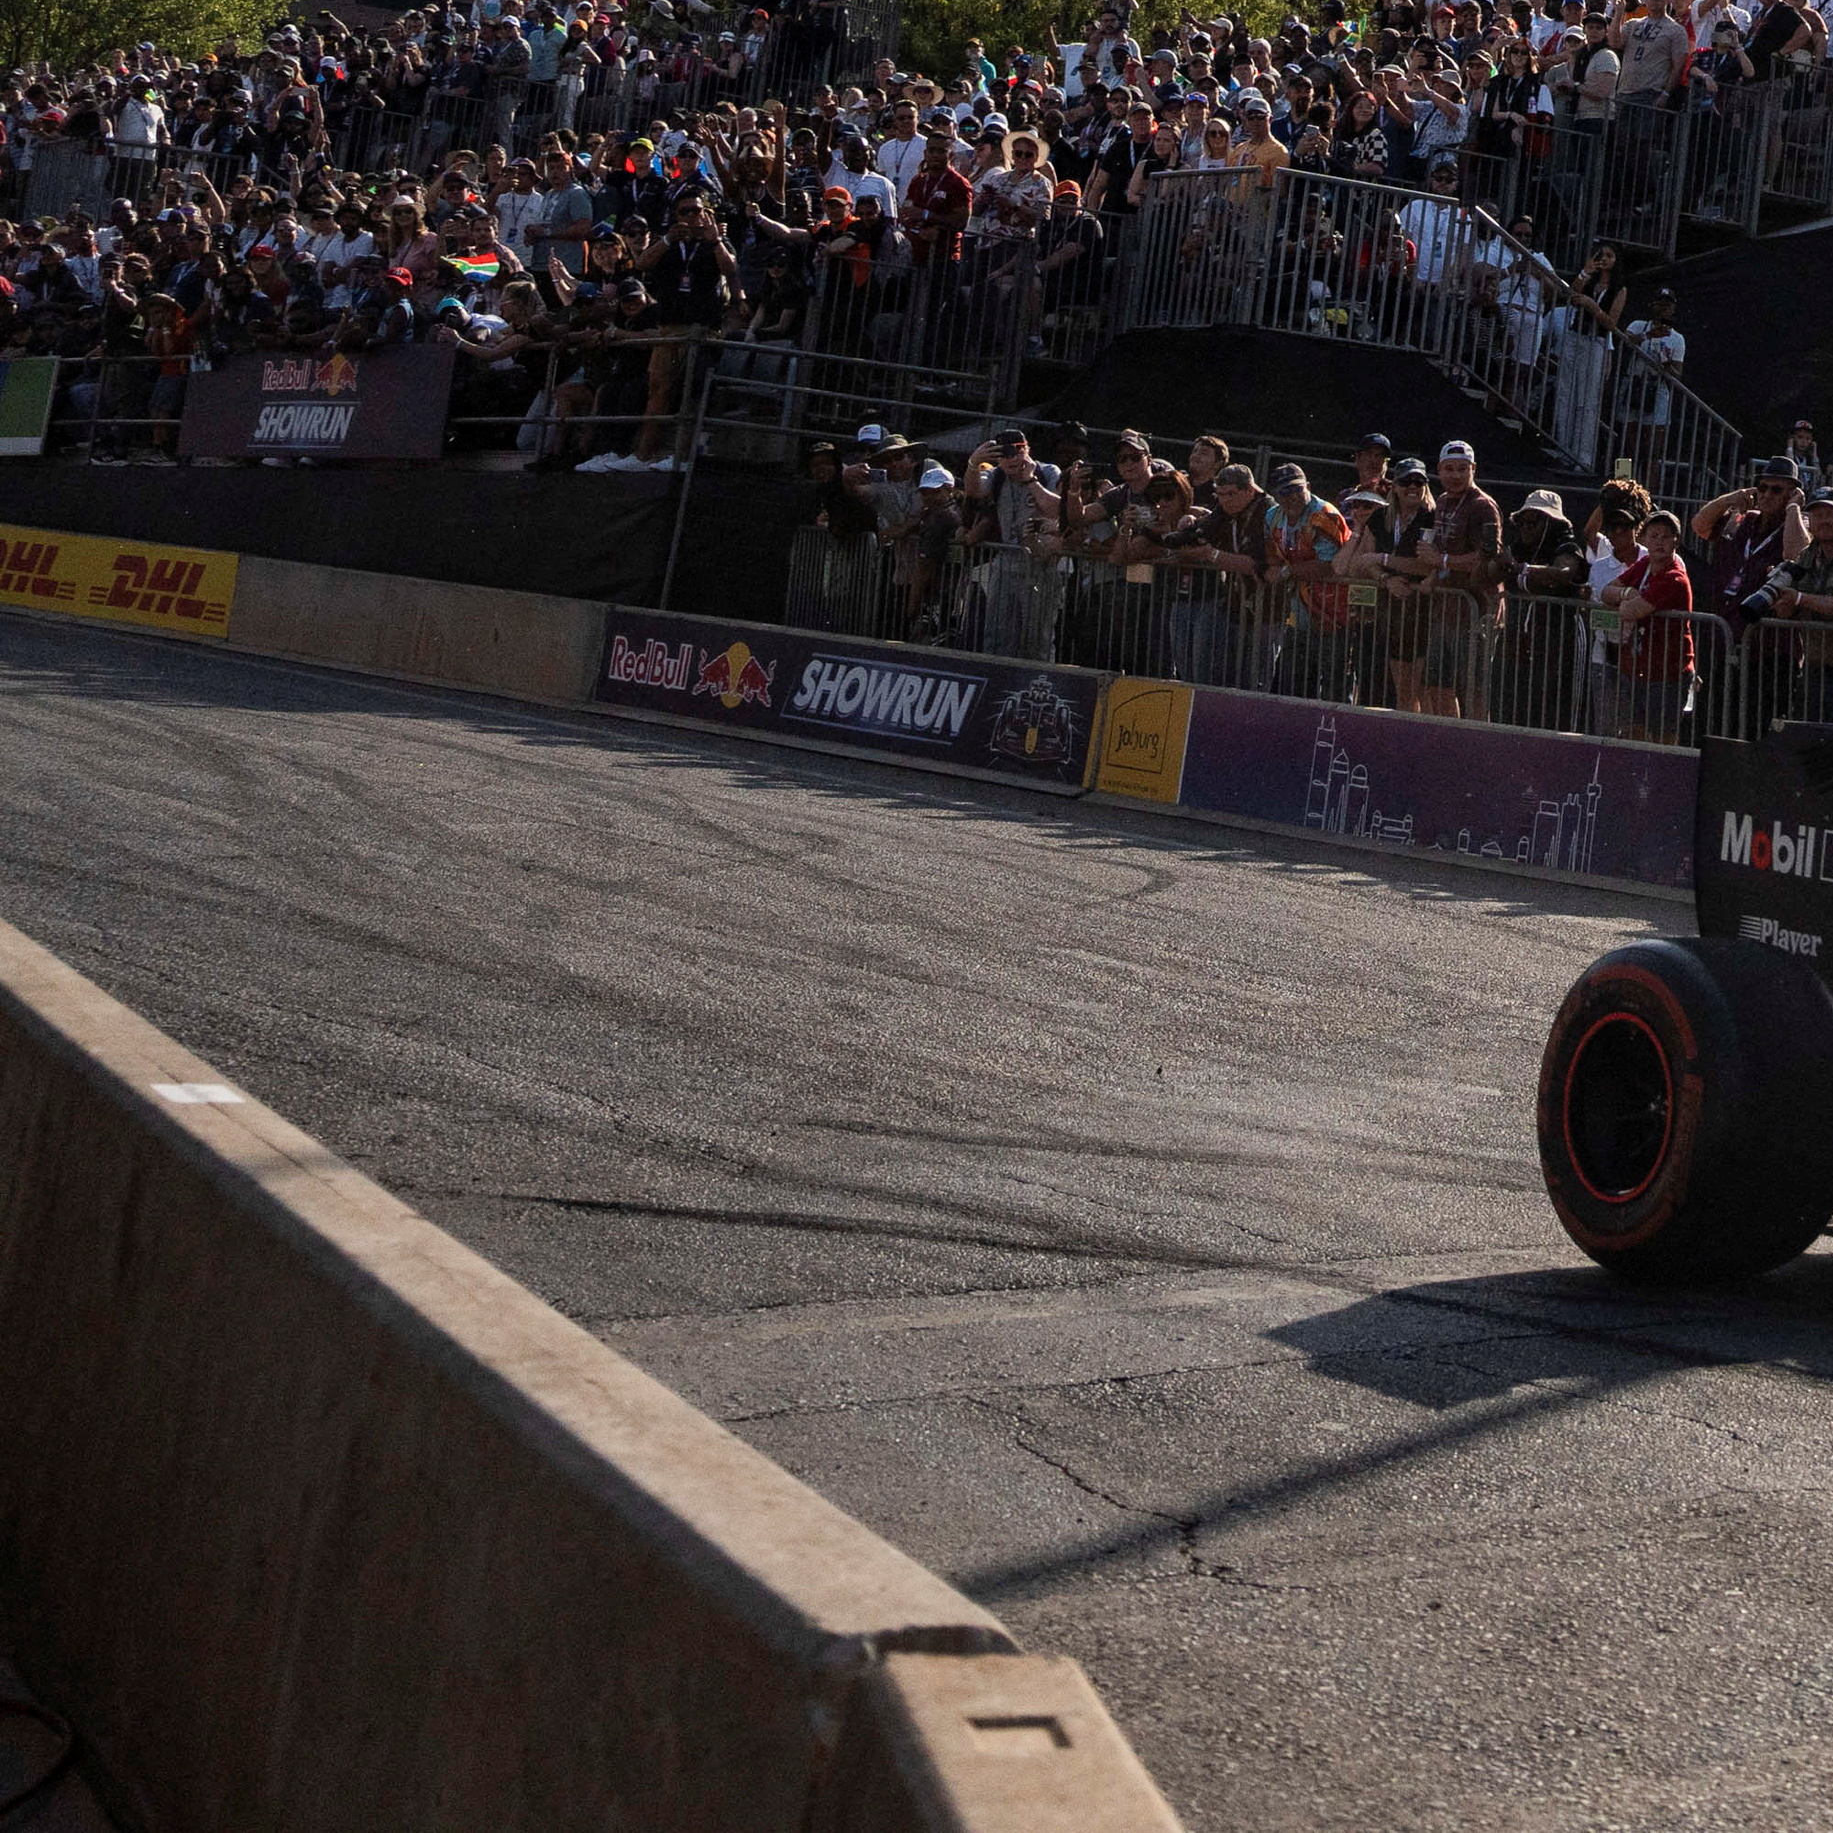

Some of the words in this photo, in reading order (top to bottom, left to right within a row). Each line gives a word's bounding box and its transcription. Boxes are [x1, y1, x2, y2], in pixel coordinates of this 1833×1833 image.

[262, 361, 289, 391] Red
[288, 359, 312, 389] Bull
[253, 405, 355, 442] SHOWRUN
[106, 554, 206, 620] DHL
[609, 635, 652, 685] Red
[649, 640, 694, 690] Bull
[793, 659, 977, 737] SHOWRUN
[1720, 811, 1816, 878] Mobil
[1760, 918, 1823, 957] Player
